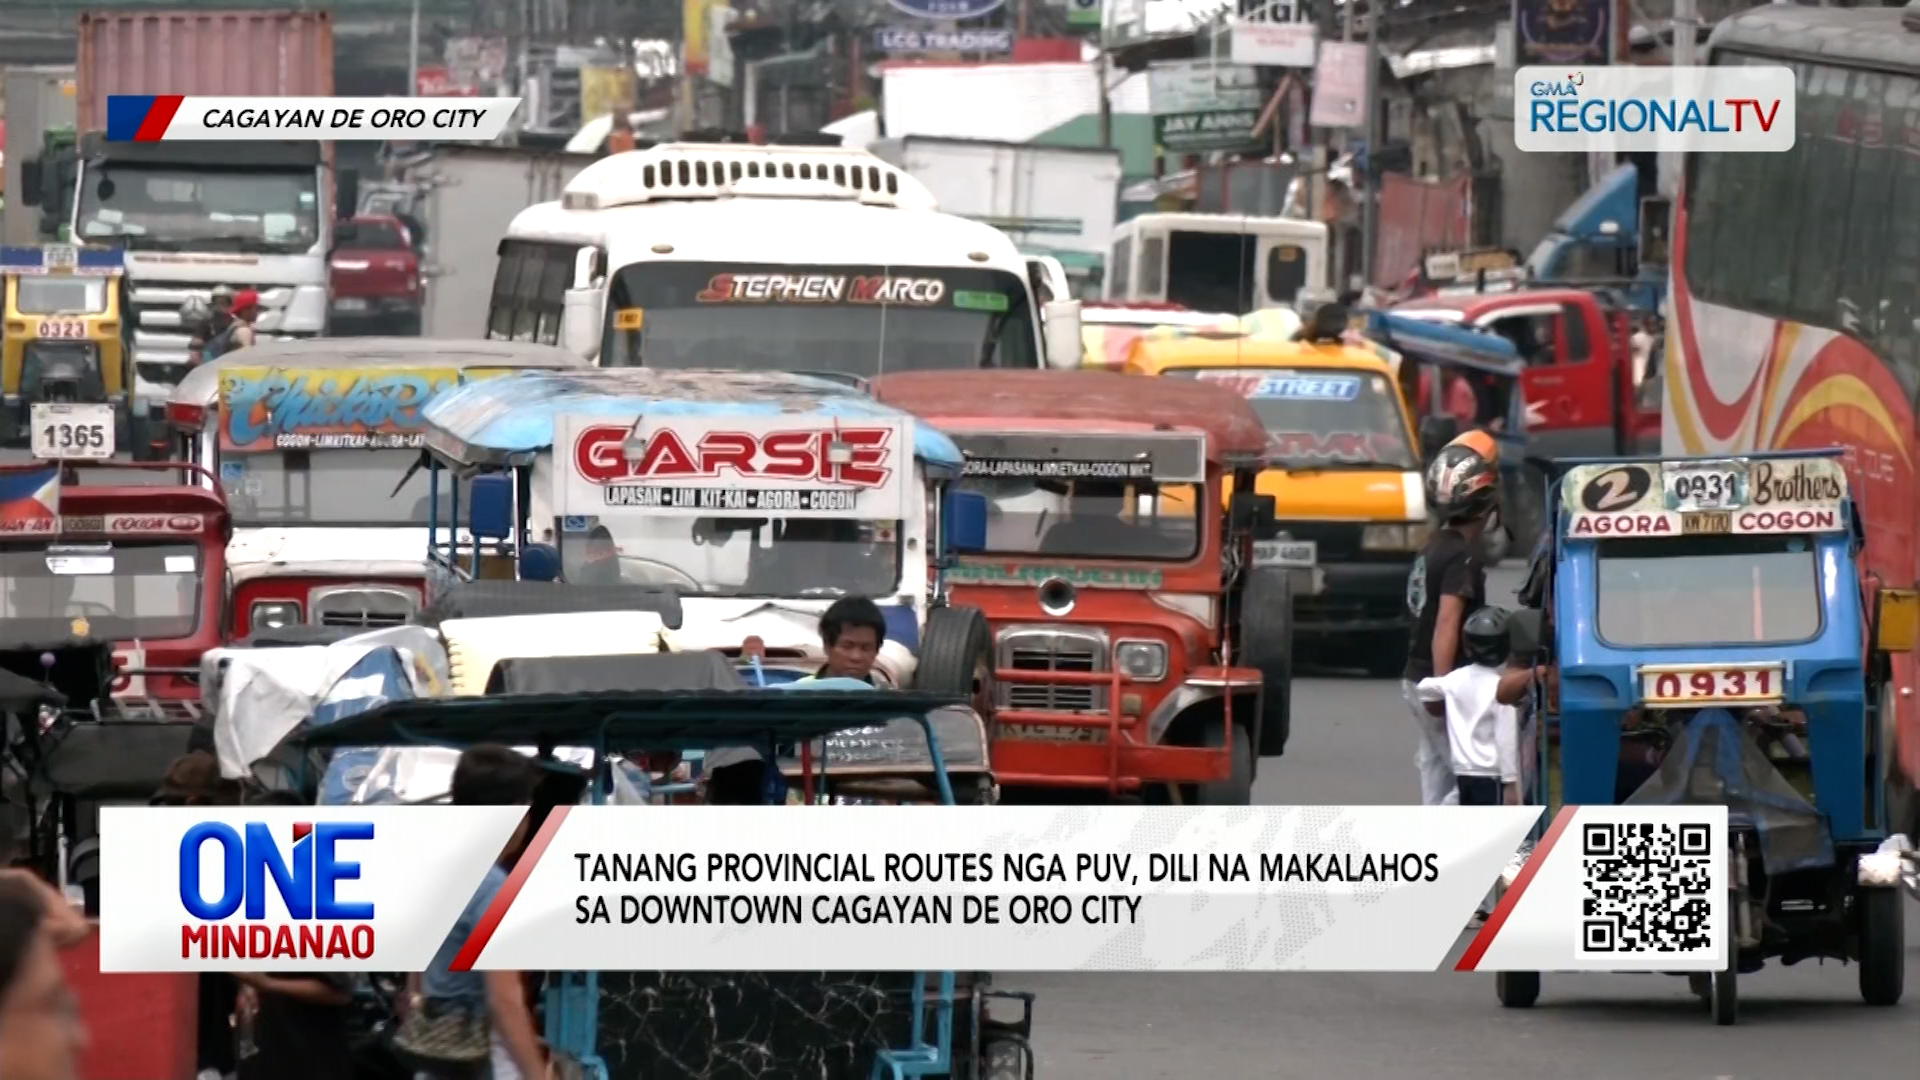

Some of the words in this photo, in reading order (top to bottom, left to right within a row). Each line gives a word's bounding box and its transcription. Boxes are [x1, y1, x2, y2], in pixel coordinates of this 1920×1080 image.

[925, 31, 1010, 49] TRADING
[696, 272, 846, 302] STEPHEN
[847, 275, 945, 303] MARCO
[40, 321, 85, 339] 0323
[44, 423, 104, 448] 1365
[573, 423, 893, 490] GARSIE
[1674, 469, 1736, 500] 0931
[1753, 461, 1841, 506] Brothers
[604, 486, 662, 507] LAPASAN
[672, 487, 695, 507] LIM
[756, 488, 800, 509] AGORA
[809, 489, 856, 509] COGON
[1574, 513, 1671, 534] AGORA
[1738, 511, 1834, 530] COGON
[1655, 669, 1770, 699] 0931
